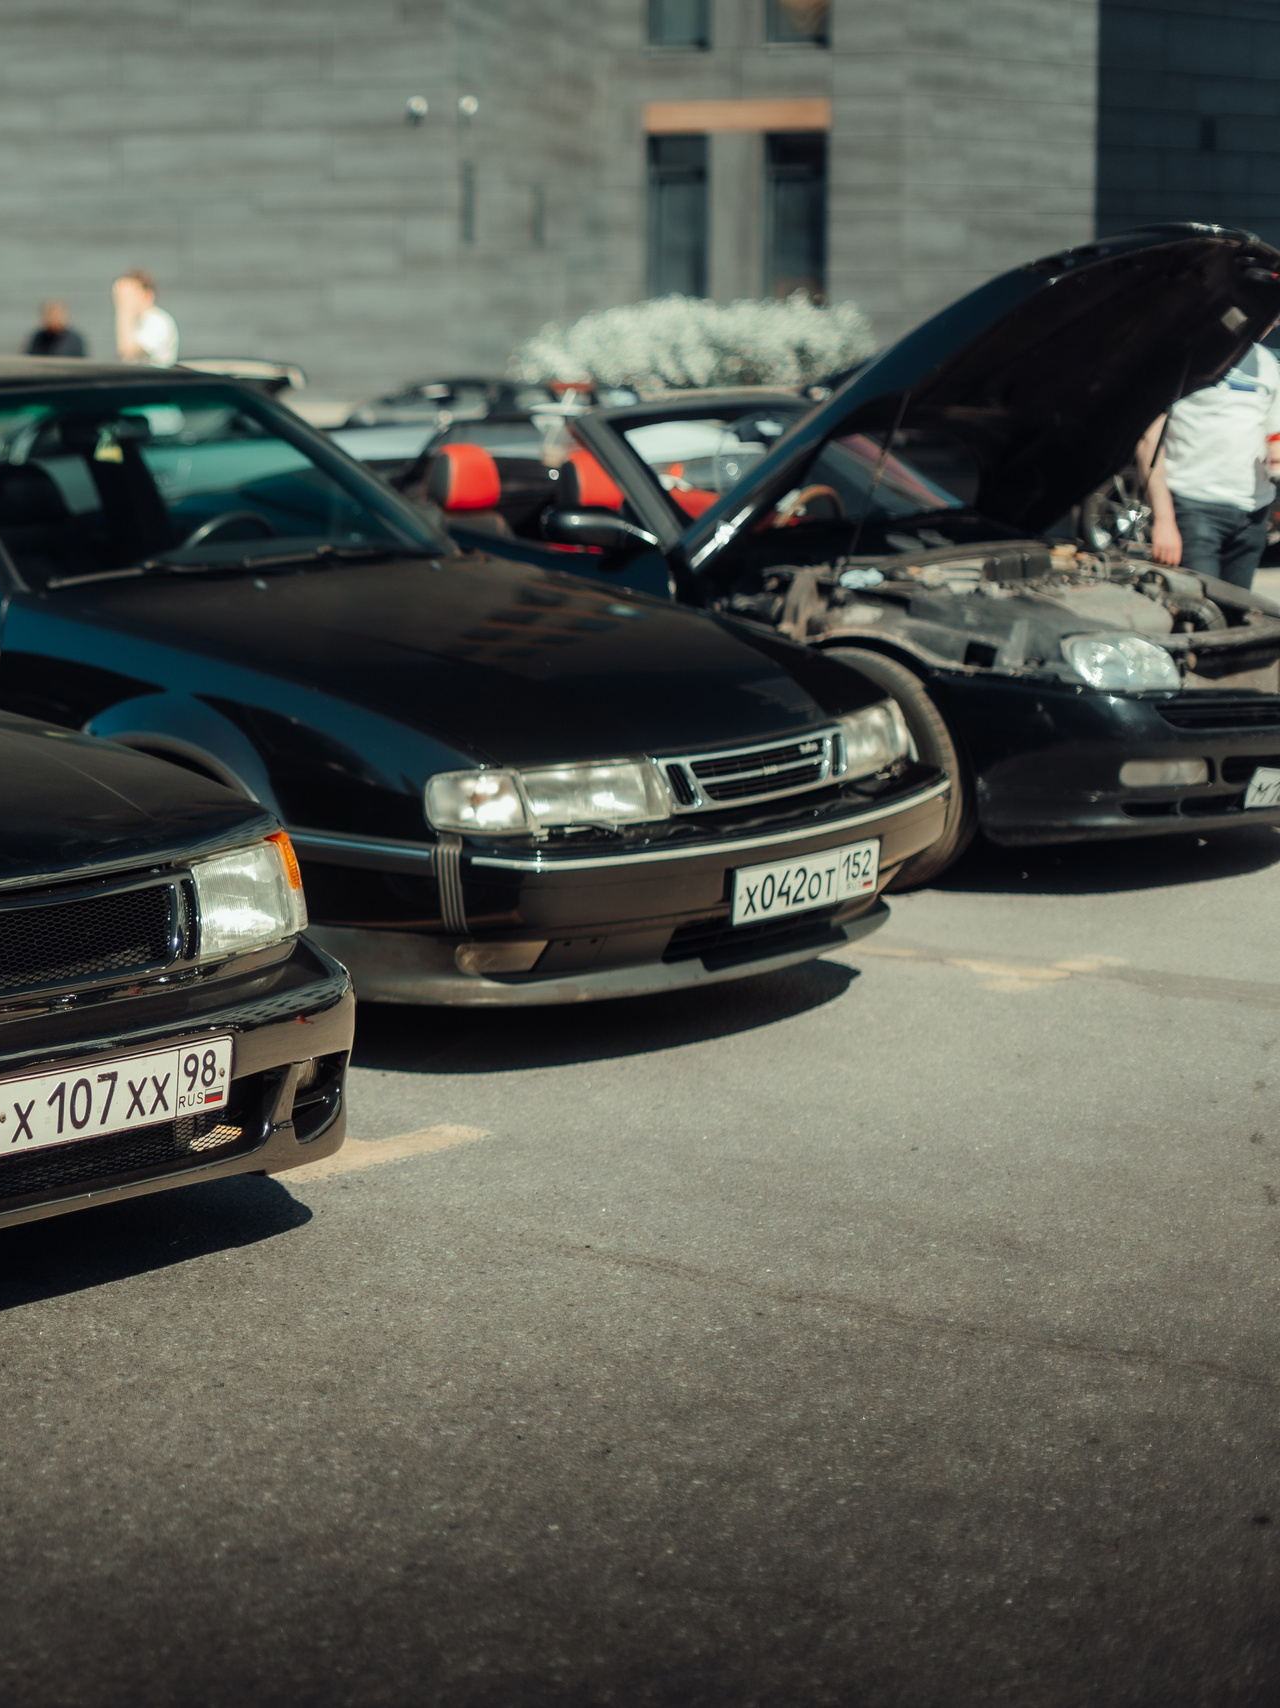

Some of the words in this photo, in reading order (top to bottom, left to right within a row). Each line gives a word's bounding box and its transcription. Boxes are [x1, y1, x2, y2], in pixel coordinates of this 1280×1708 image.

[842, 849, 872, 881] 152
[183, 1049, 217, 1092] 98
[178, 1091, 204, 1109] RUS
